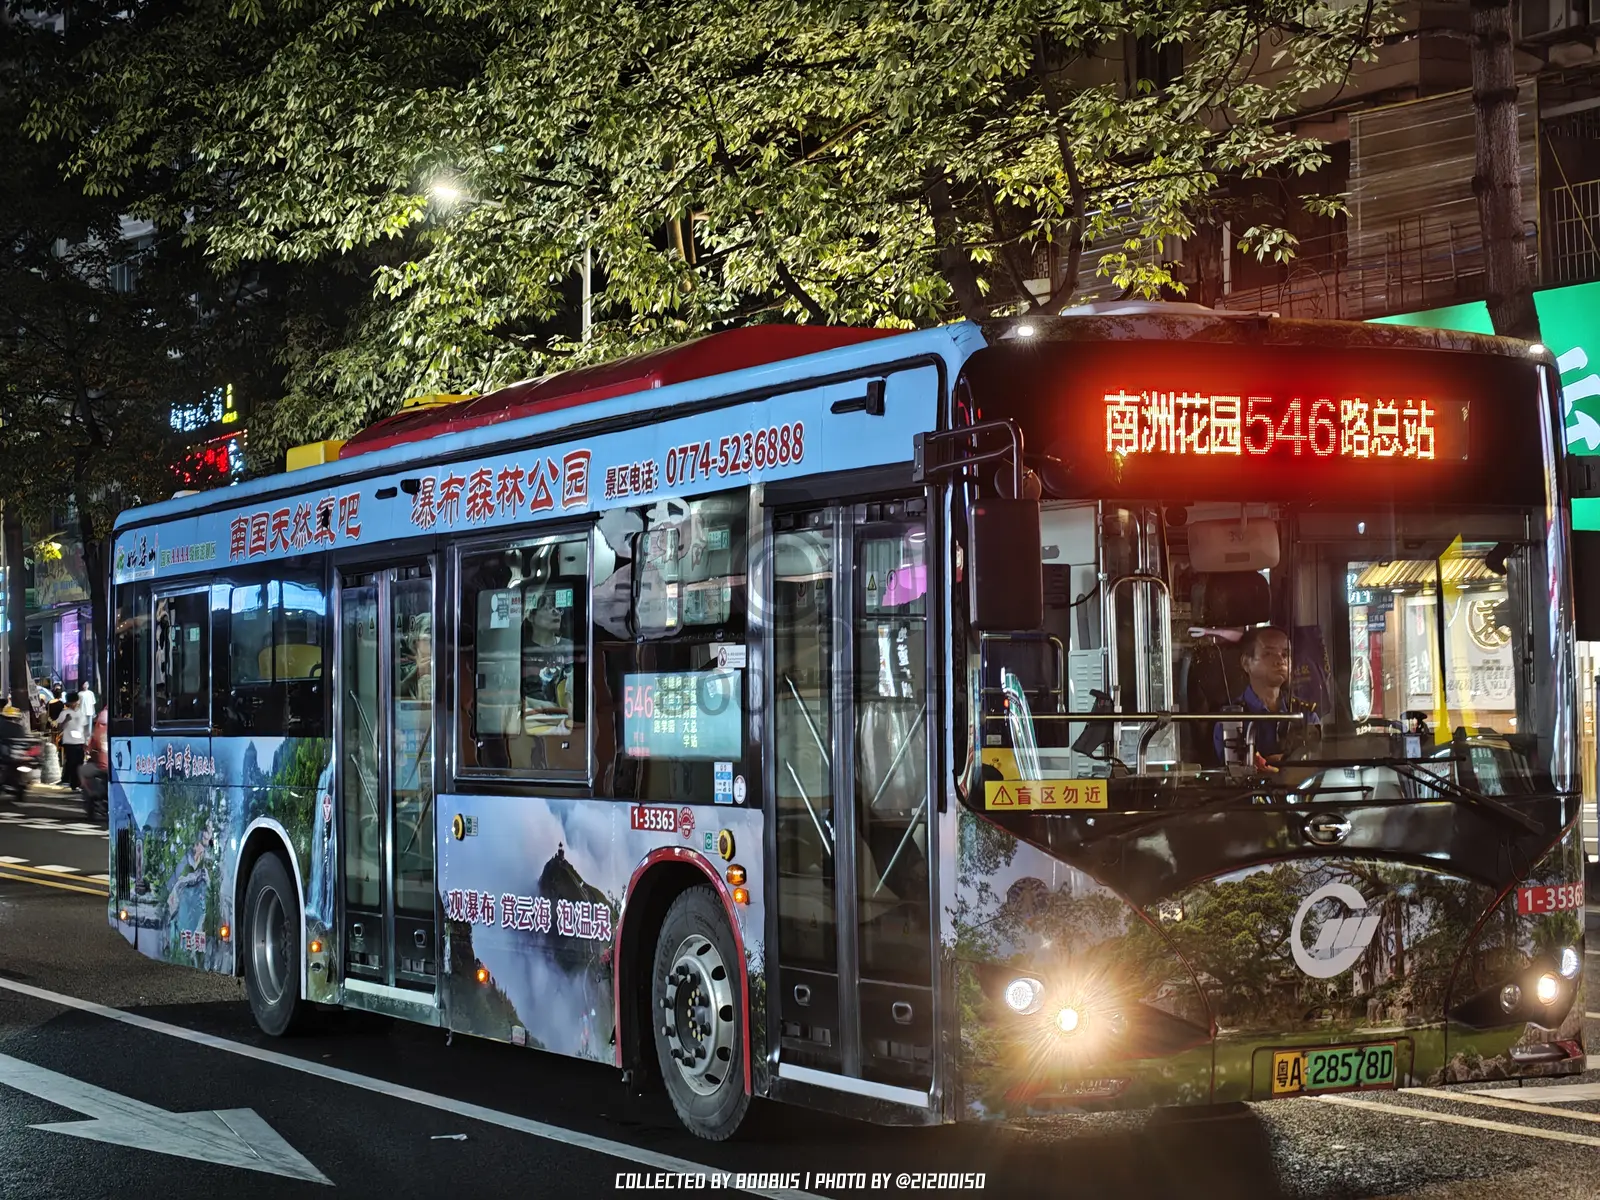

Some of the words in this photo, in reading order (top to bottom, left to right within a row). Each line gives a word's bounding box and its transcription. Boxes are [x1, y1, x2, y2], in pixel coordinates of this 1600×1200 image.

[665, 421, 804, 486] 0774-5236888
[410, 449, 592, 531] 瀑布森林公园
[229, 492, 361, 562] 南国天然氧吧
[625, 685, 654, 718] 546
[1015, 786, 1101, 805] 盲区勿近
[633, 808, 675, 831] 1-35363
[449, 888, 495, 926] 观瀑布
[501, 892, 551, 934] 赏云海
[557, 899, 611, 941] 泡温泉
[1312, 1050, 1393, 1085] 28578D
